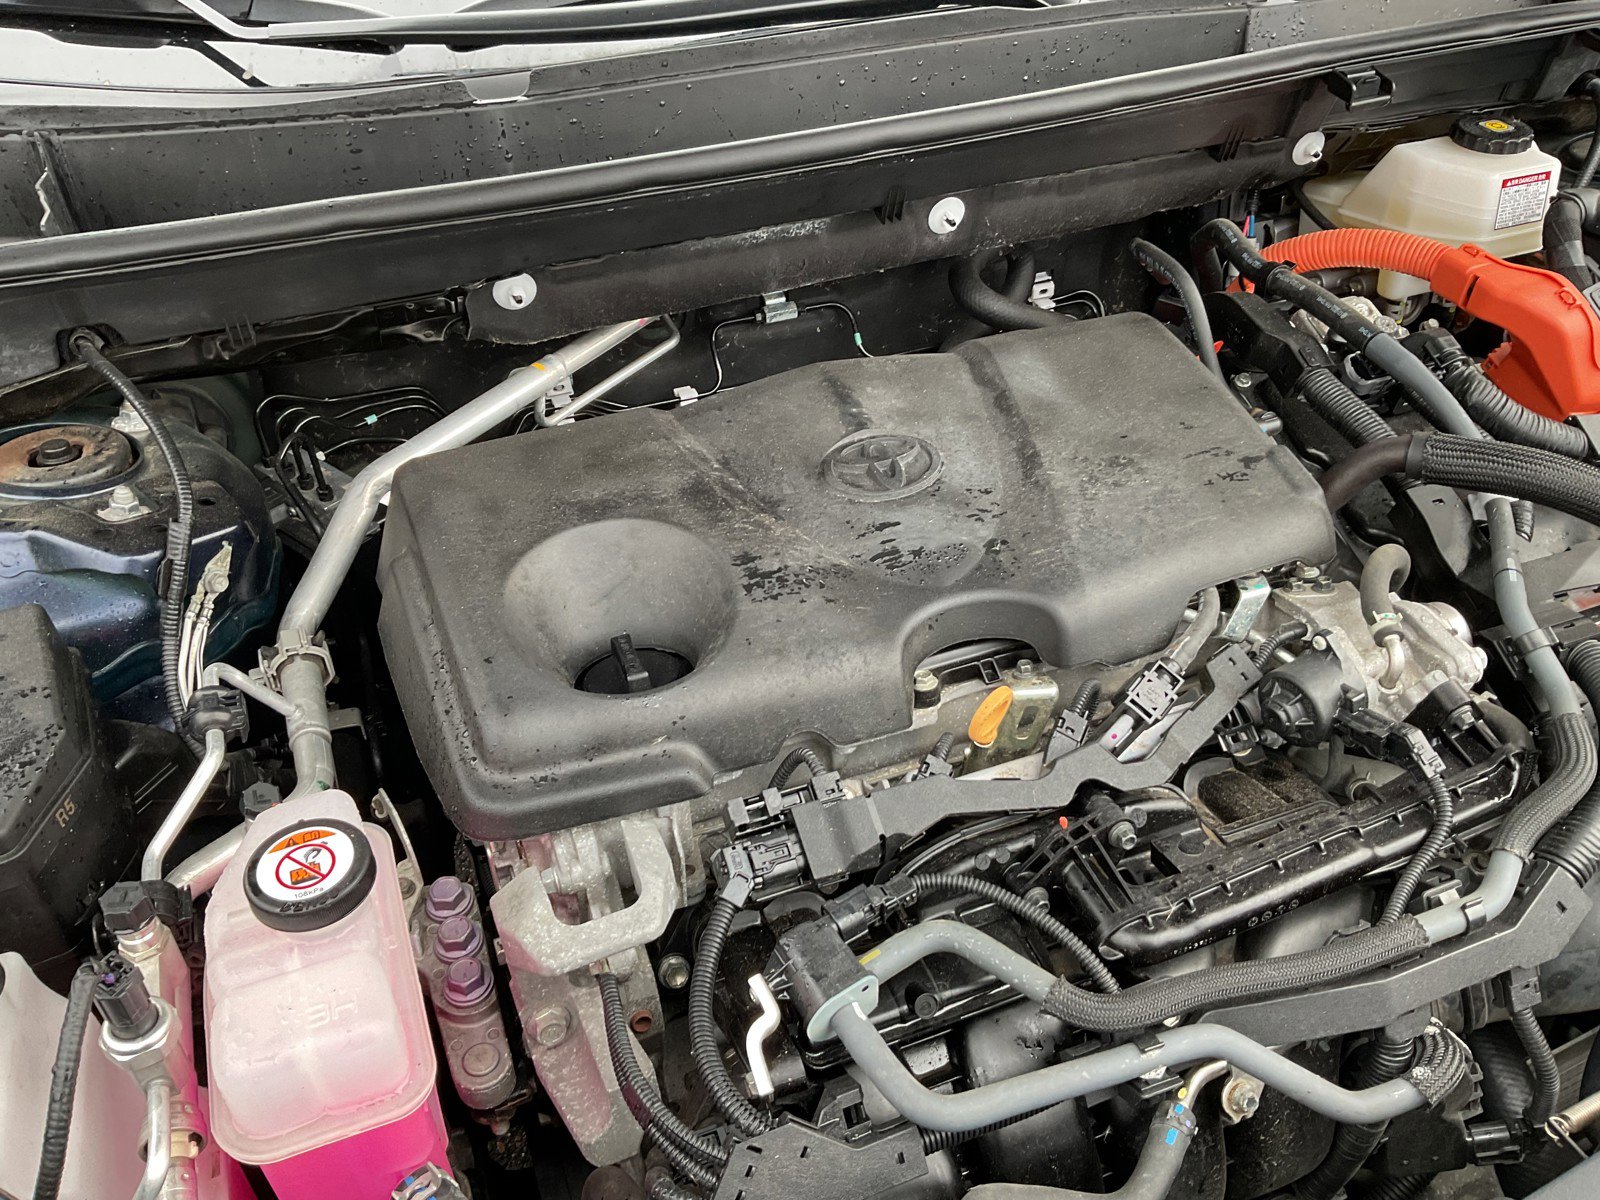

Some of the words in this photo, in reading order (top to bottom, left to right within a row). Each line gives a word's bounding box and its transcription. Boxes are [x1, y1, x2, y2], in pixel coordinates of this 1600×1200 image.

[1519, 175, 1539, 184] DANGER
[55, 794, 75, 828] R5
[294, 887, 324, 899] 108kPa
